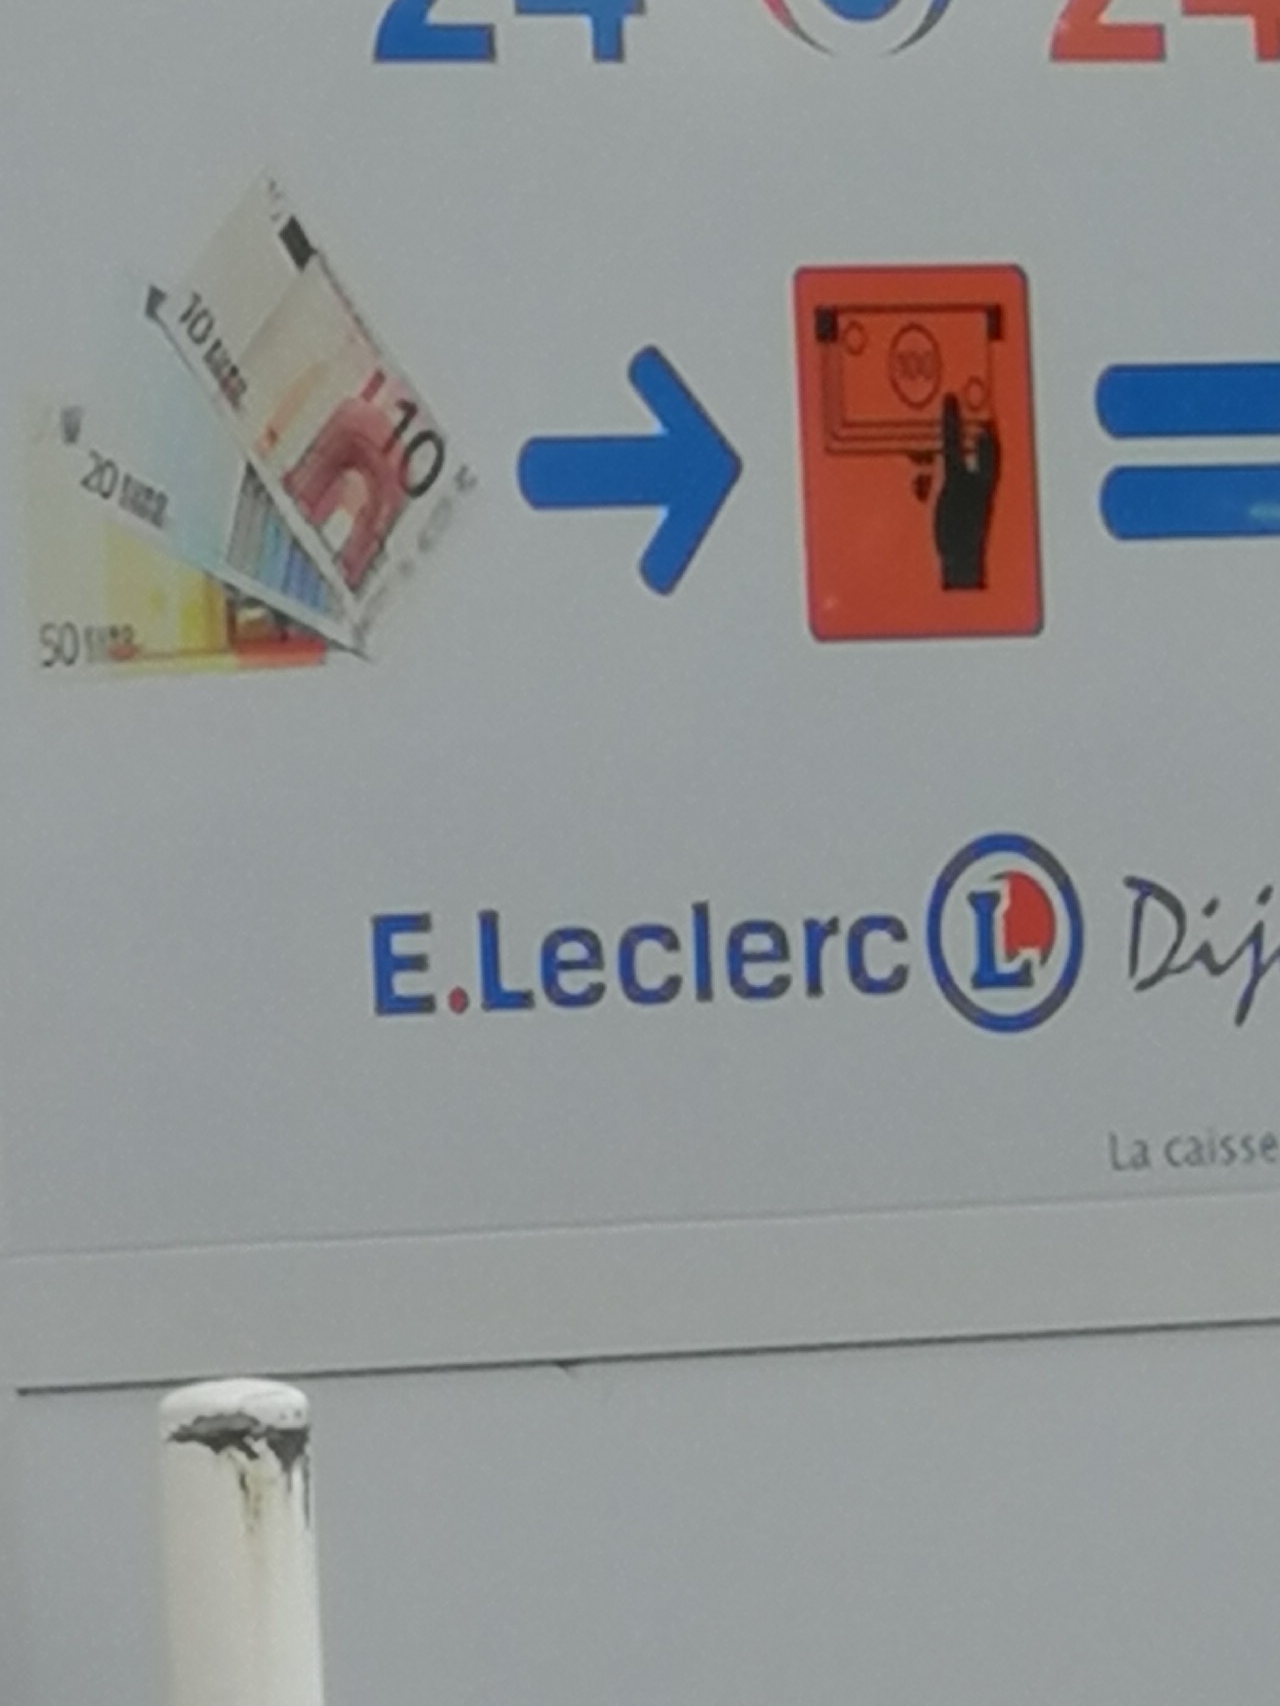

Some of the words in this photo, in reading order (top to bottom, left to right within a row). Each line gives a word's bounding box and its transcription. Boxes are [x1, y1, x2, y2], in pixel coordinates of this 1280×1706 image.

[383, 398, 446, 498] 10
[80, 449, 119, 500] 20
[40, 622, 79, 668] 50
[370, 900, 909, 1016] E.Leclerc
[1109, 1130, 1151, 1172] La
[1163, 1129, 1279, 1168] caisse
